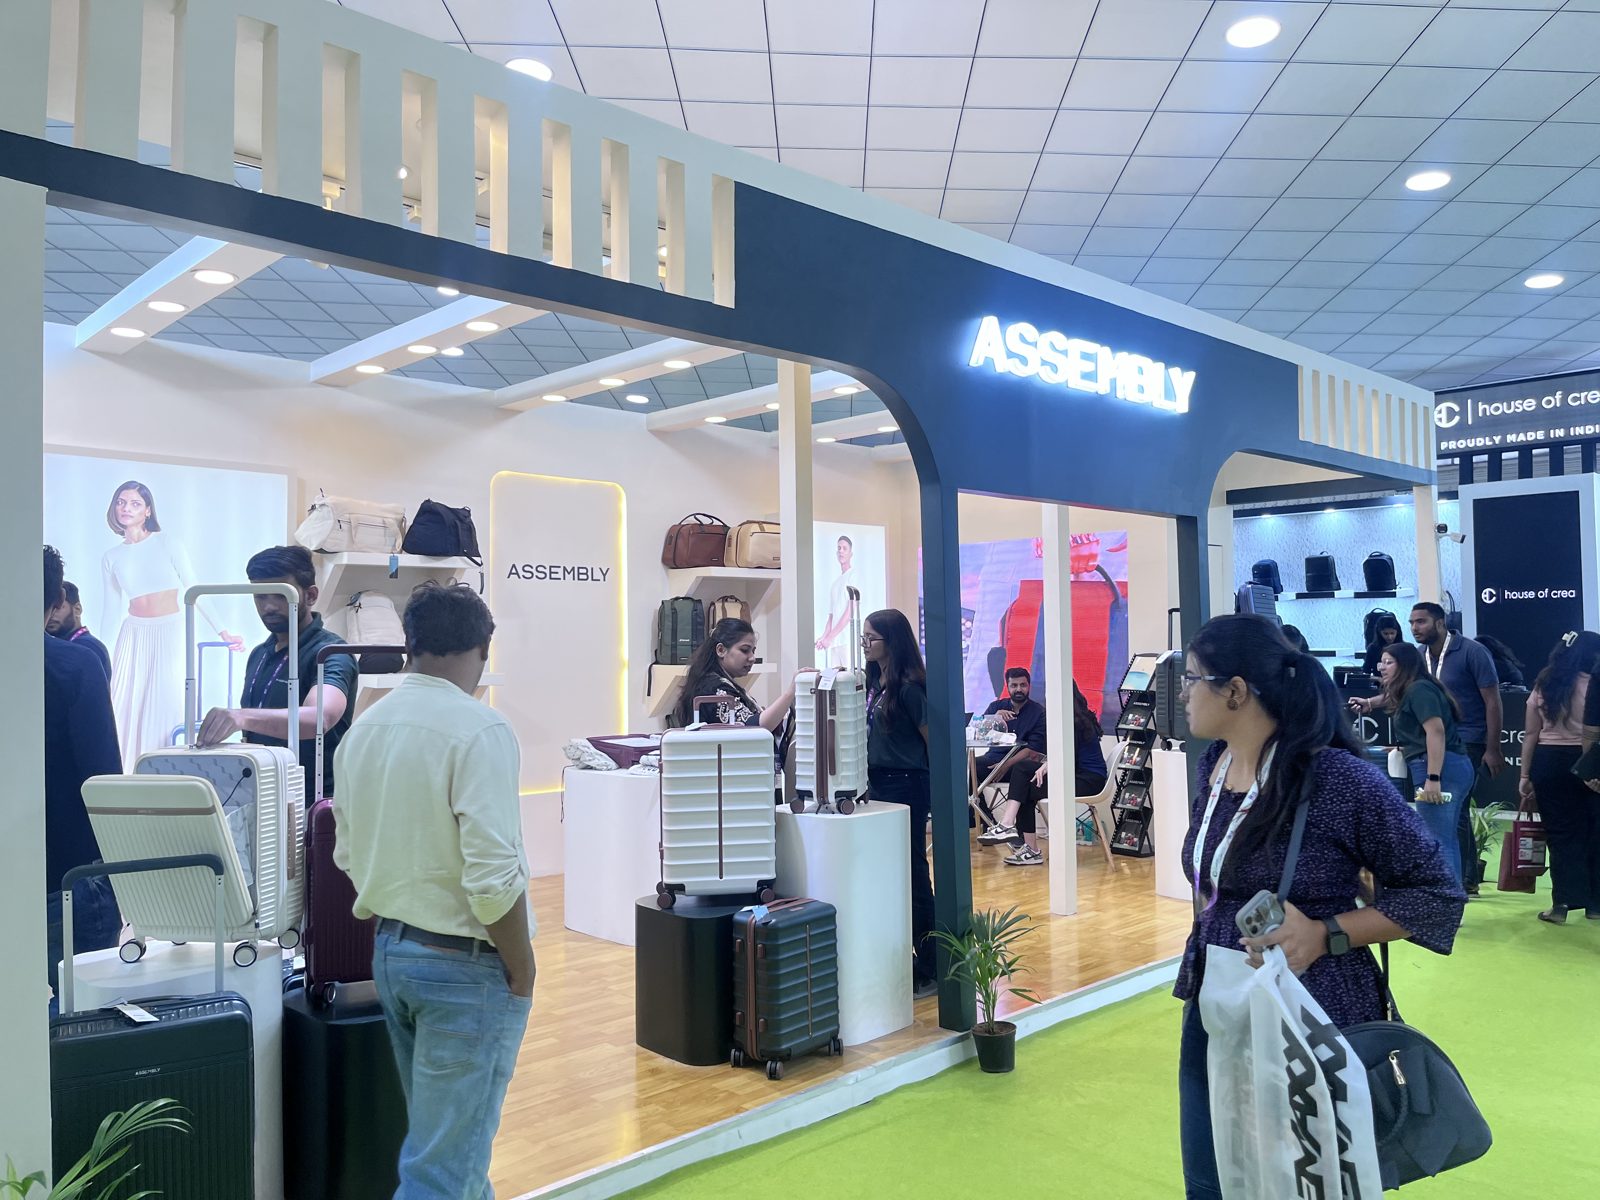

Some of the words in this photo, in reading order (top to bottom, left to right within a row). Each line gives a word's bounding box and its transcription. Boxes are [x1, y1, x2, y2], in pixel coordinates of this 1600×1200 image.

[968, 315, 1196, 414] ASSEMBLY
[1478, 398, 1537, 417] house
[1541, 390, 1563, 409] of
[1440, 435, 1502, 450] PROUDLY
[1506, 430, 1545, 443] MADE
[1549, 428, 1565, 439] IN
[507, 563, 610, 582] ASSEMBLY
[1504, 589, 1536, 599] house
[1537, 588, 1549, 598] of
[1550, 589, 1576, 599] crea
